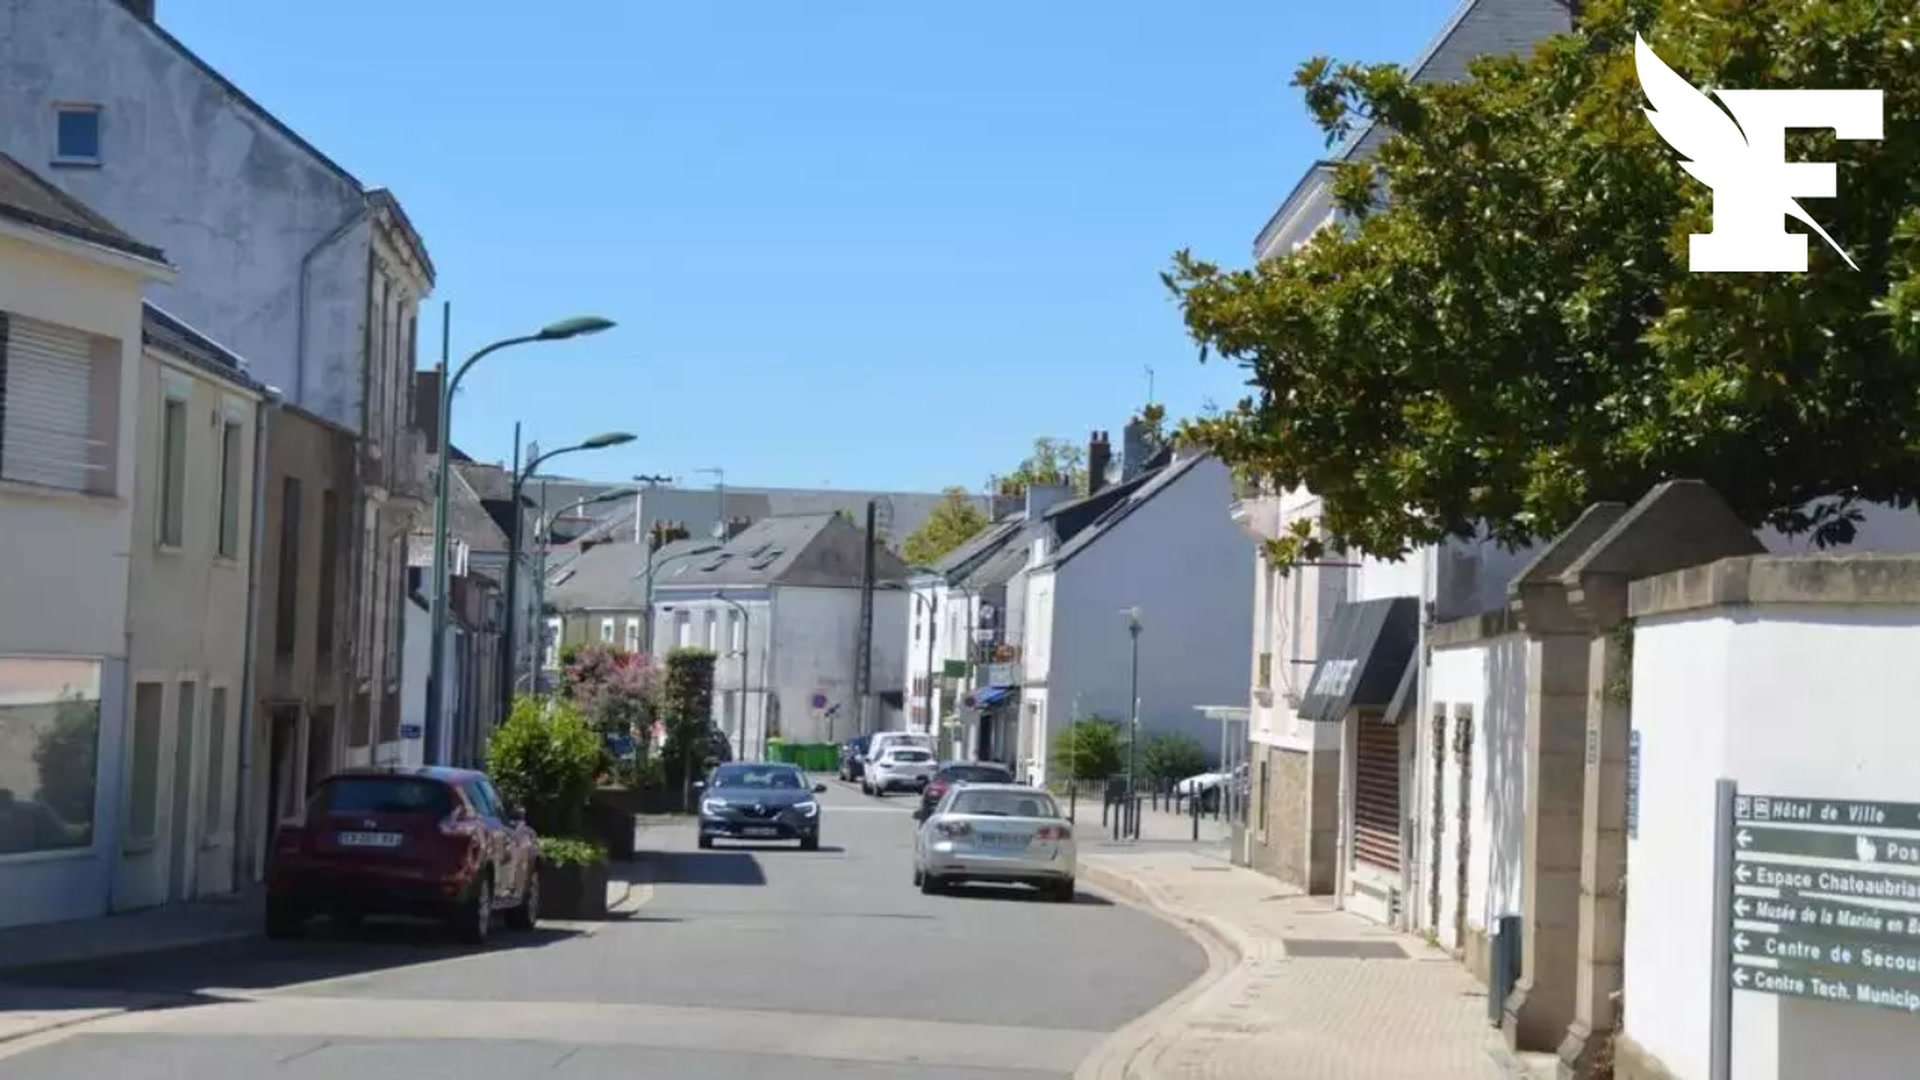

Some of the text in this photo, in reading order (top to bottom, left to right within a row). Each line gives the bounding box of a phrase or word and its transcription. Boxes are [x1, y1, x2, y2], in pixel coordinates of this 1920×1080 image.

[1772, 801, 1885, 823] Hôtel de Ville
[1757, 867, 1812, 887] Espace
[1756, 901, 1796, 920] Musée
[1801, 907, 1817, 923] de
[1821, 908, 1833, 925] la
[1837, 910, 1883, 930] Marine
[1887, 918, 1904, 933] en
[1766, 938, 1821, 959] Centre
[1831, 945, 1852, 964] de
[1754, 971, 1805, 993] Centre
[1811, 978, 1850, 999] Tech.
